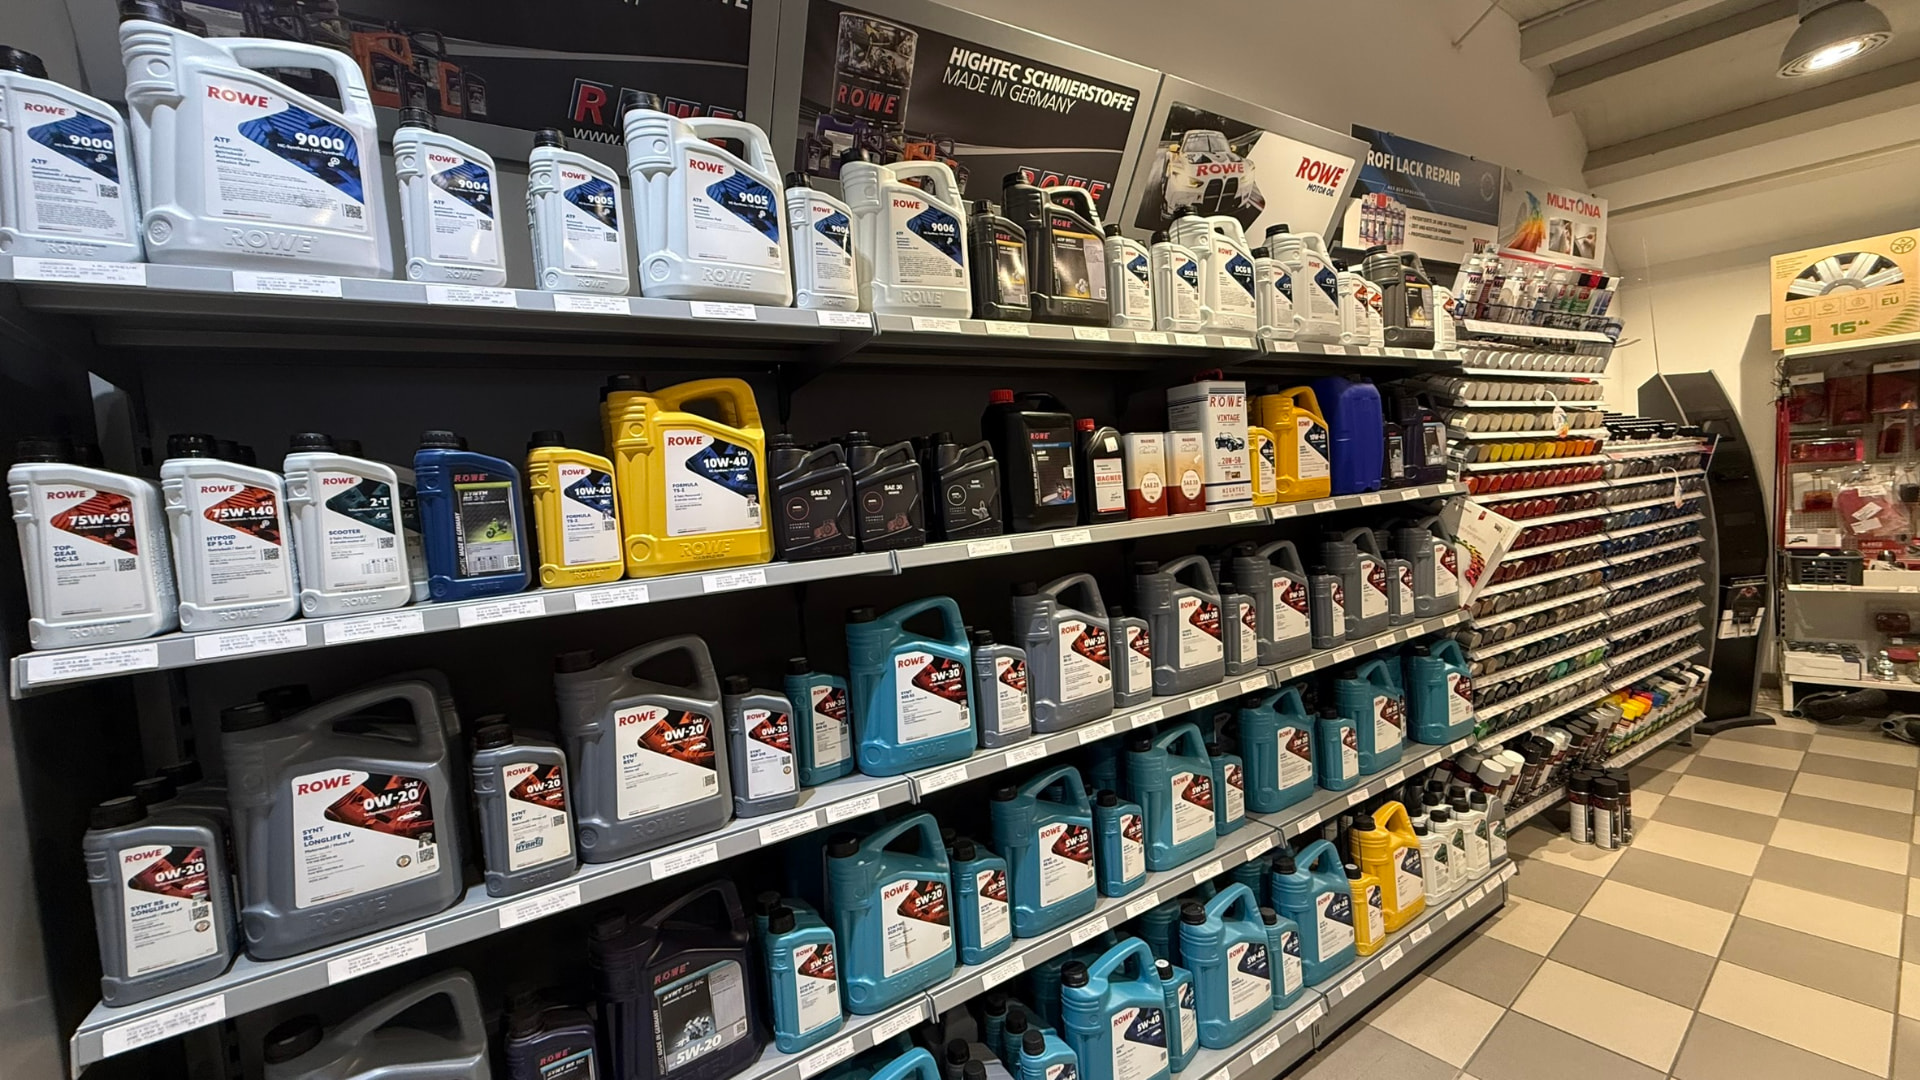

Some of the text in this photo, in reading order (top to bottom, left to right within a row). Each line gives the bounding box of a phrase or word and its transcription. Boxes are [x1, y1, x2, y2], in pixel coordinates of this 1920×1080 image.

[949, 47, 1136, 113] HIGHTEC SCHMIERSTOFFE
[943, 66, 1077, 115] MADE IN GERMANY
[207, 86, 269, 109] ROWE
[838, 84, 897, 115] ROWE
[24, 102, 66, 116] ROWE
[69, 134, 114, 149] 9000
[213, 136, 231, 144] ATF
[294, 132, 345, 151] 9000
[429, 154, 458, 164] ROWE
[689, 159, 724, 175] ROWE
[1196, 163, 1245, 177] ROWE
[1296, 157, 1346, 189] ROWE
[1367, 150, 1461, 188] ROFI LACK REPAIR
[562, 171, 587, 181] ROWE
[458, 179, 488, 191] 9004
[588, 194, 614, 205] 9005
[739, 192, 768, 205] 9005
[893, 199, 921, 210] ROWE
[813, 206, 831, 214] ROWE
[931, 223, 955, 233] 9006
[1881, 296, 1899, 306] EU
[1794, 328, 1802, 336] 4
[1210, 395, 1242, 408] ROWE
[1217, 413, 1240, 422] VINTAGE
[667, 436, 703, 446] ROWE
[1030, 432, 1049, 440] ROWE
[703, 456, 748, 469] 10W-40
[454, 473, 487, 483] ROWE
[561, 468, 586, 477] ROWE
[322, 477, 355, 485] ROWE
[47, 490, 86, 500] ROWE
[201, 485, 235, 494] ROWE
[574, 486, 612, 496] 10W-40
[370, 496, 390, 507] 2-T
[68, 512, 130, 526] 75W-90
[212, 506, 274, 519] 75W-140
[328, 528, 361, 536] SCOOTER
[1180, 600, 1198, 609] ROWE
[1061, 624, 1081, 635] ROWE
[898, 656, 925, 668] ROWE
[931, 668, 960, 682] 5W-30
[813, 688, 829, 696] ROWE
[619, 711, 656, 727] ROWE
[746, 712, 766, 720] ROWE
[664, 725, 704, 742] 0W-20
[761, 725, 788, 736] 0W-20
[507, 766, 531, 777] ROWE
[298, 774, 352, 796] ROWE
[404, 780, 418, 789] SAE
[527, 779, 561, 794] 0W-20
[363, 788, 419, 811] 0W-20
[302, 826, 324, 835] SYNT
[1041, 826, 1061, 839] ROWE
[304, 834, 342, 848] LONGLIFE
[1065, 833, 1088, 848] 5W-30
[125, 848, 163, 863] ROWE
[155, 862, 206, 882] 0W-20
[884, 882, 910, 900] ROWE
[915, 888, 943, 907] 5W-20
[131, 901, 153, 911] SYNT
[131, 904, 170, 917] LONGLIFE
[1229, 945, 1245, 959] ROWE
[810, 954, 833, 969] 5W-20
[654, 964, 687, 984] ROWE
[1113, 1010, 1134, 1027] ROWE
[1137, 1015, 1160, 1032] 5W-40
[676, 1034, 722, 1065] 5W-20
[540, 1051, 568, 1066] ROWE
